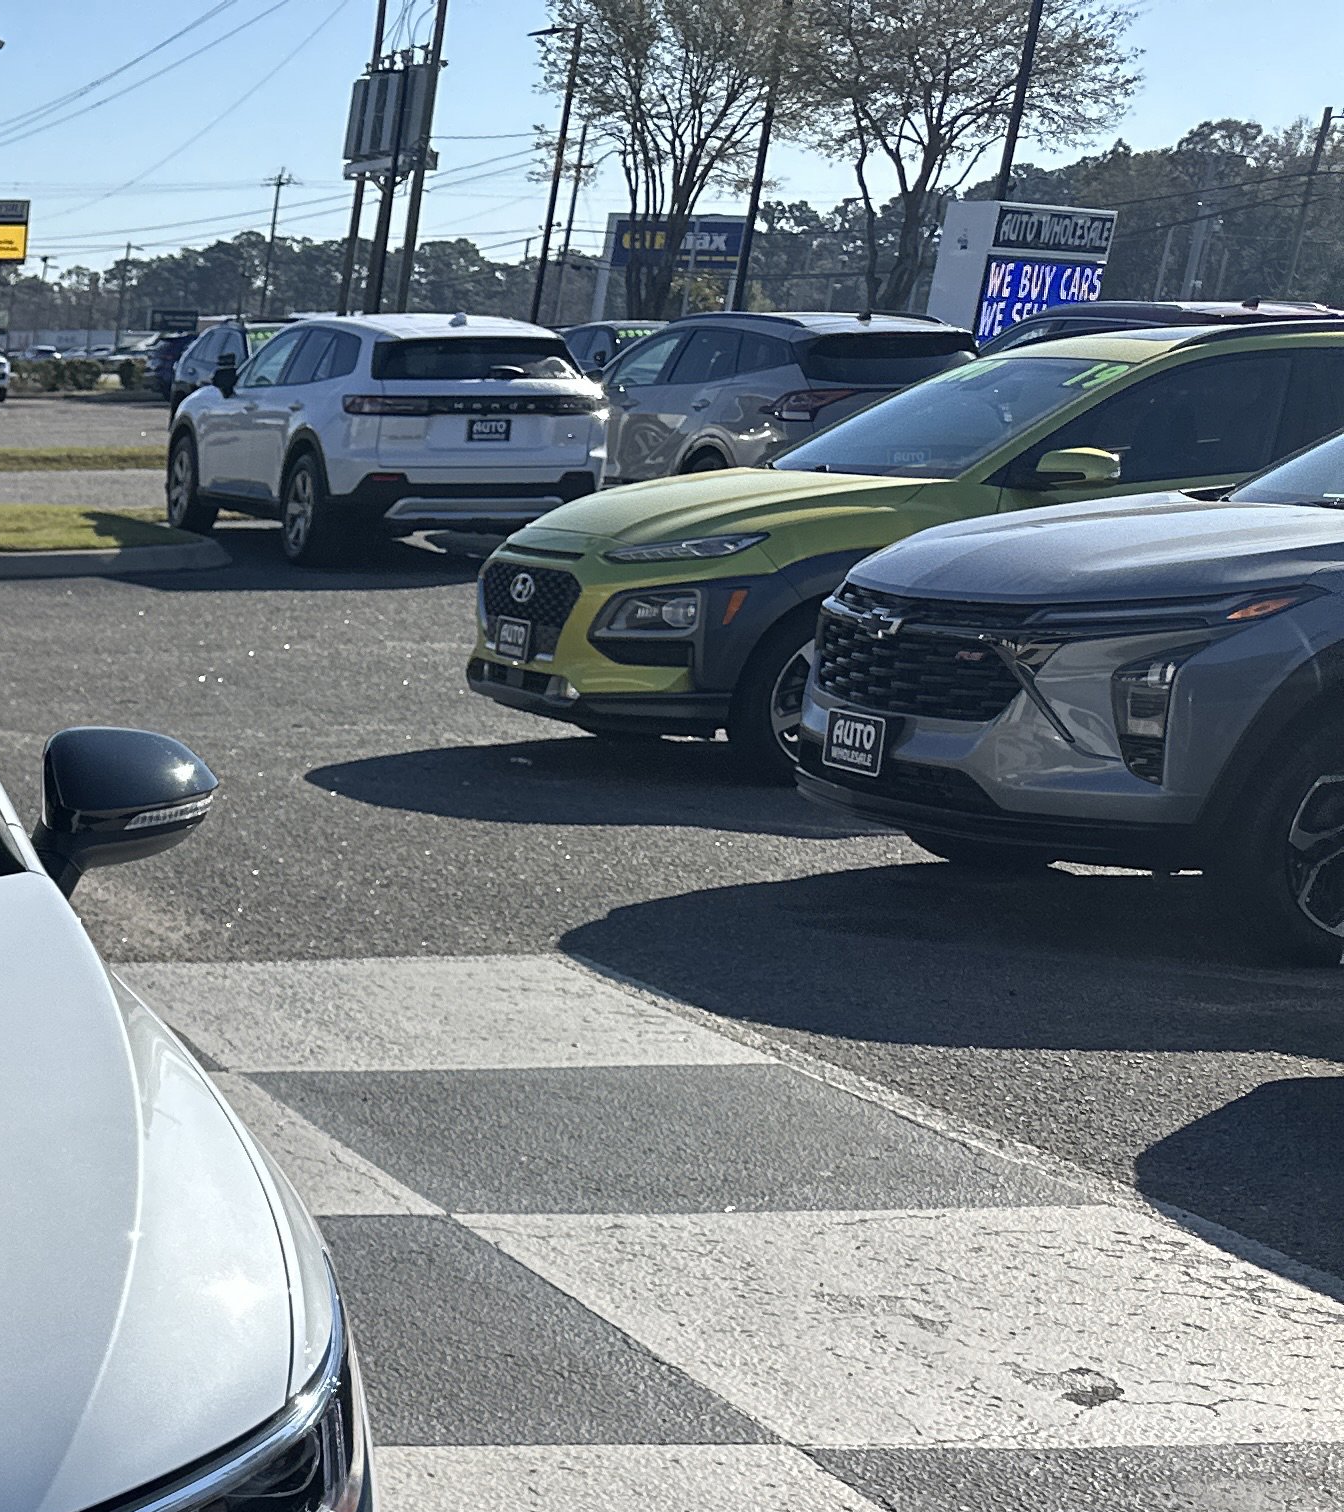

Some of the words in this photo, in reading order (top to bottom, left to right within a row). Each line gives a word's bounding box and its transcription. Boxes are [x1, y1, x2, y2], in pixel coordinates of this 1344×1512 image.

[999, 213, 1039, 242] AUTO
[1039, 215, 1112, 249] WHOLESALE
[987, 262, 1015, 299] WE
[1017, 264, 1057, 301] BUY
[1059, 267, 1103, 301] CARS
[978, 301, 1006, 337] WE
[1011, 301, 1048, 323] SE
[473, 421, 507, 433] AUTO
[500, 624, 525, 645] AUTO
[833, 719, 876, 750] AUTO
